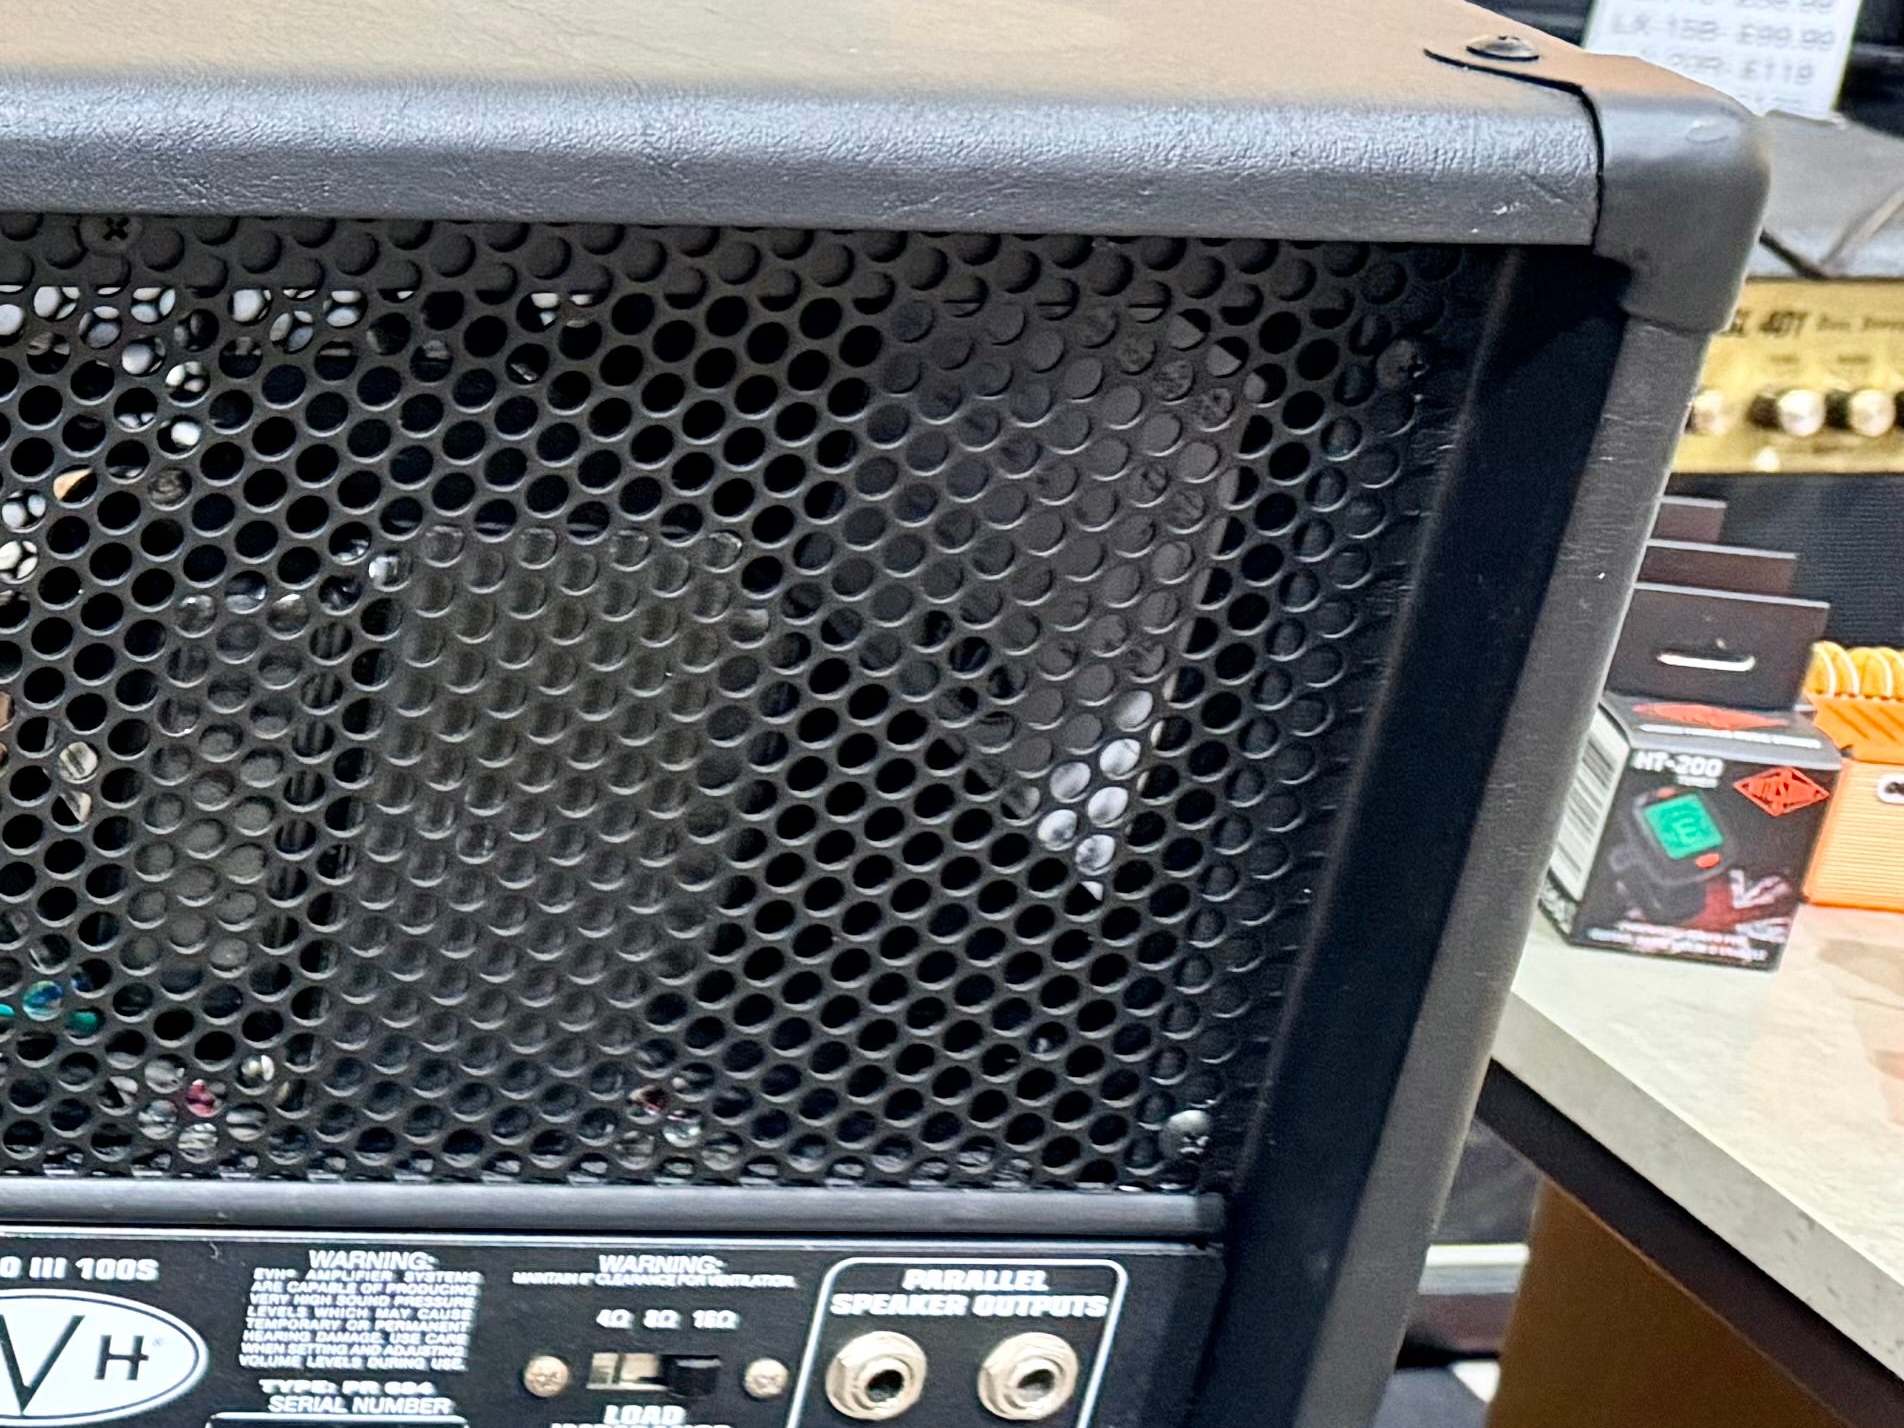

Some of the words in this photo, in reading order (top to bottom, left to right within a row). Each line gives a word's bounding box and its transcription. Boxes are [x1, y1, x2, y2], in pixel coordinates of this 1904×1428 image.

[29, 1256, 67, 1280] III
[75, 1258, 160, 1281] 100S
[309, 1250, 439, 1270] WARNING:
[598, 1254, 728, 1273] WARNING:
[902, 1269, 1049, 1292] PARALLEL
[830, 1293, 969, 1316] SPEAKER
[972, 1294, 1109, 1317] OUTPUTS
[268, 1395, 348, 1413] SERIAL
[352, 1397, 455, 1414] NUMBER
[603, 1404, 686, 1424] LOAD
